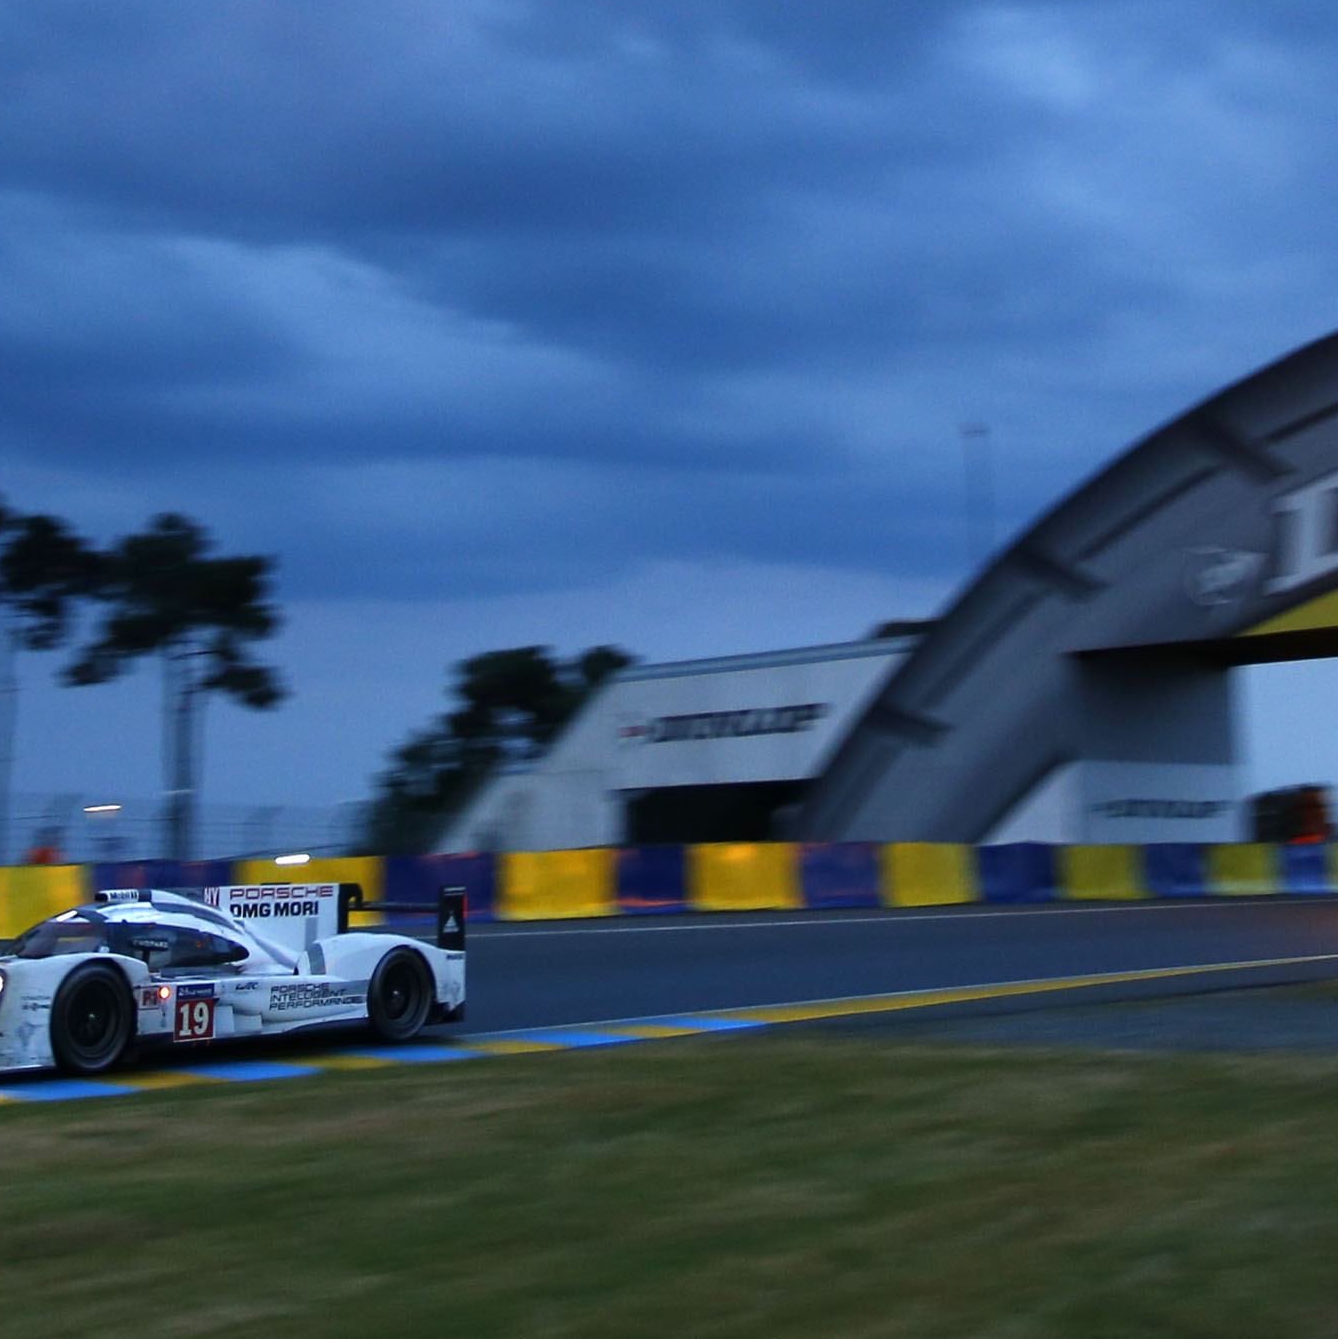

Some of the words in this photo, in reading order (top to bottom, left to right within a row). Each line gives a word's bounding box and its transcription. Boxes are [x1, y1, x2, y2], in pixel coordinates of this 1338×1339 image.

[229, 885, 334, 900] PORSCHE
[229, 903, 272, 918] DMG
[273, 901, 319, 917] MORI
[269, 982, 330, 995] PORSCHE
[178, 1001, 210, 1037] 19
